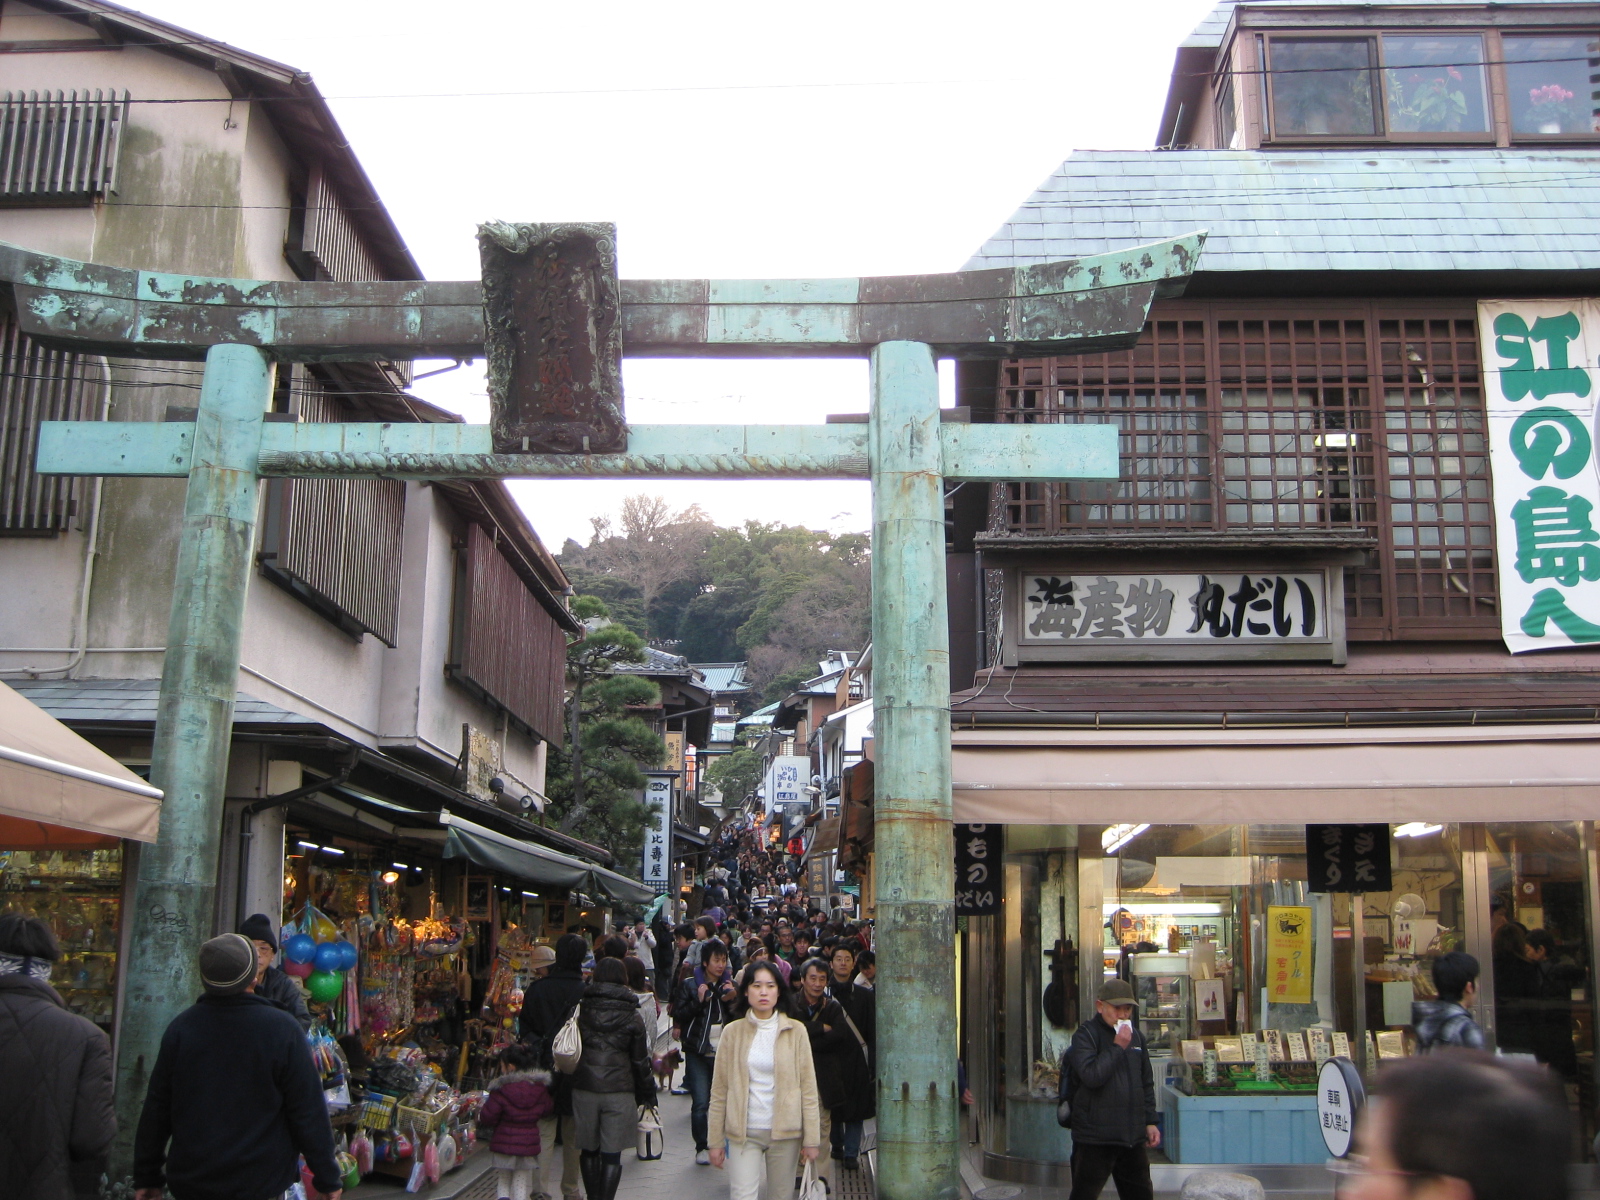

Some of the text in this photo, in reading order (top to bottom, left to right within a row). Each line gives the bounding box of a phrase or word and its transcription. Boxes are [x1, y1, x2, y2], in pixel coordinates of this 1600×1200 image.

[1493, 310, 1600, 644] 江の島へ
[1028, 575, 1316, 638] 海産物 丸だい
[1353, 824, 1376, 882] ざえ
[1274, 912, 1306, 925] クロネコヤマト
[1275, 957, 1288, 995] 宅急便
[1291, 951, 1302, 978] クール
[1322, 1111, 1349, 1133] 進入禁止
